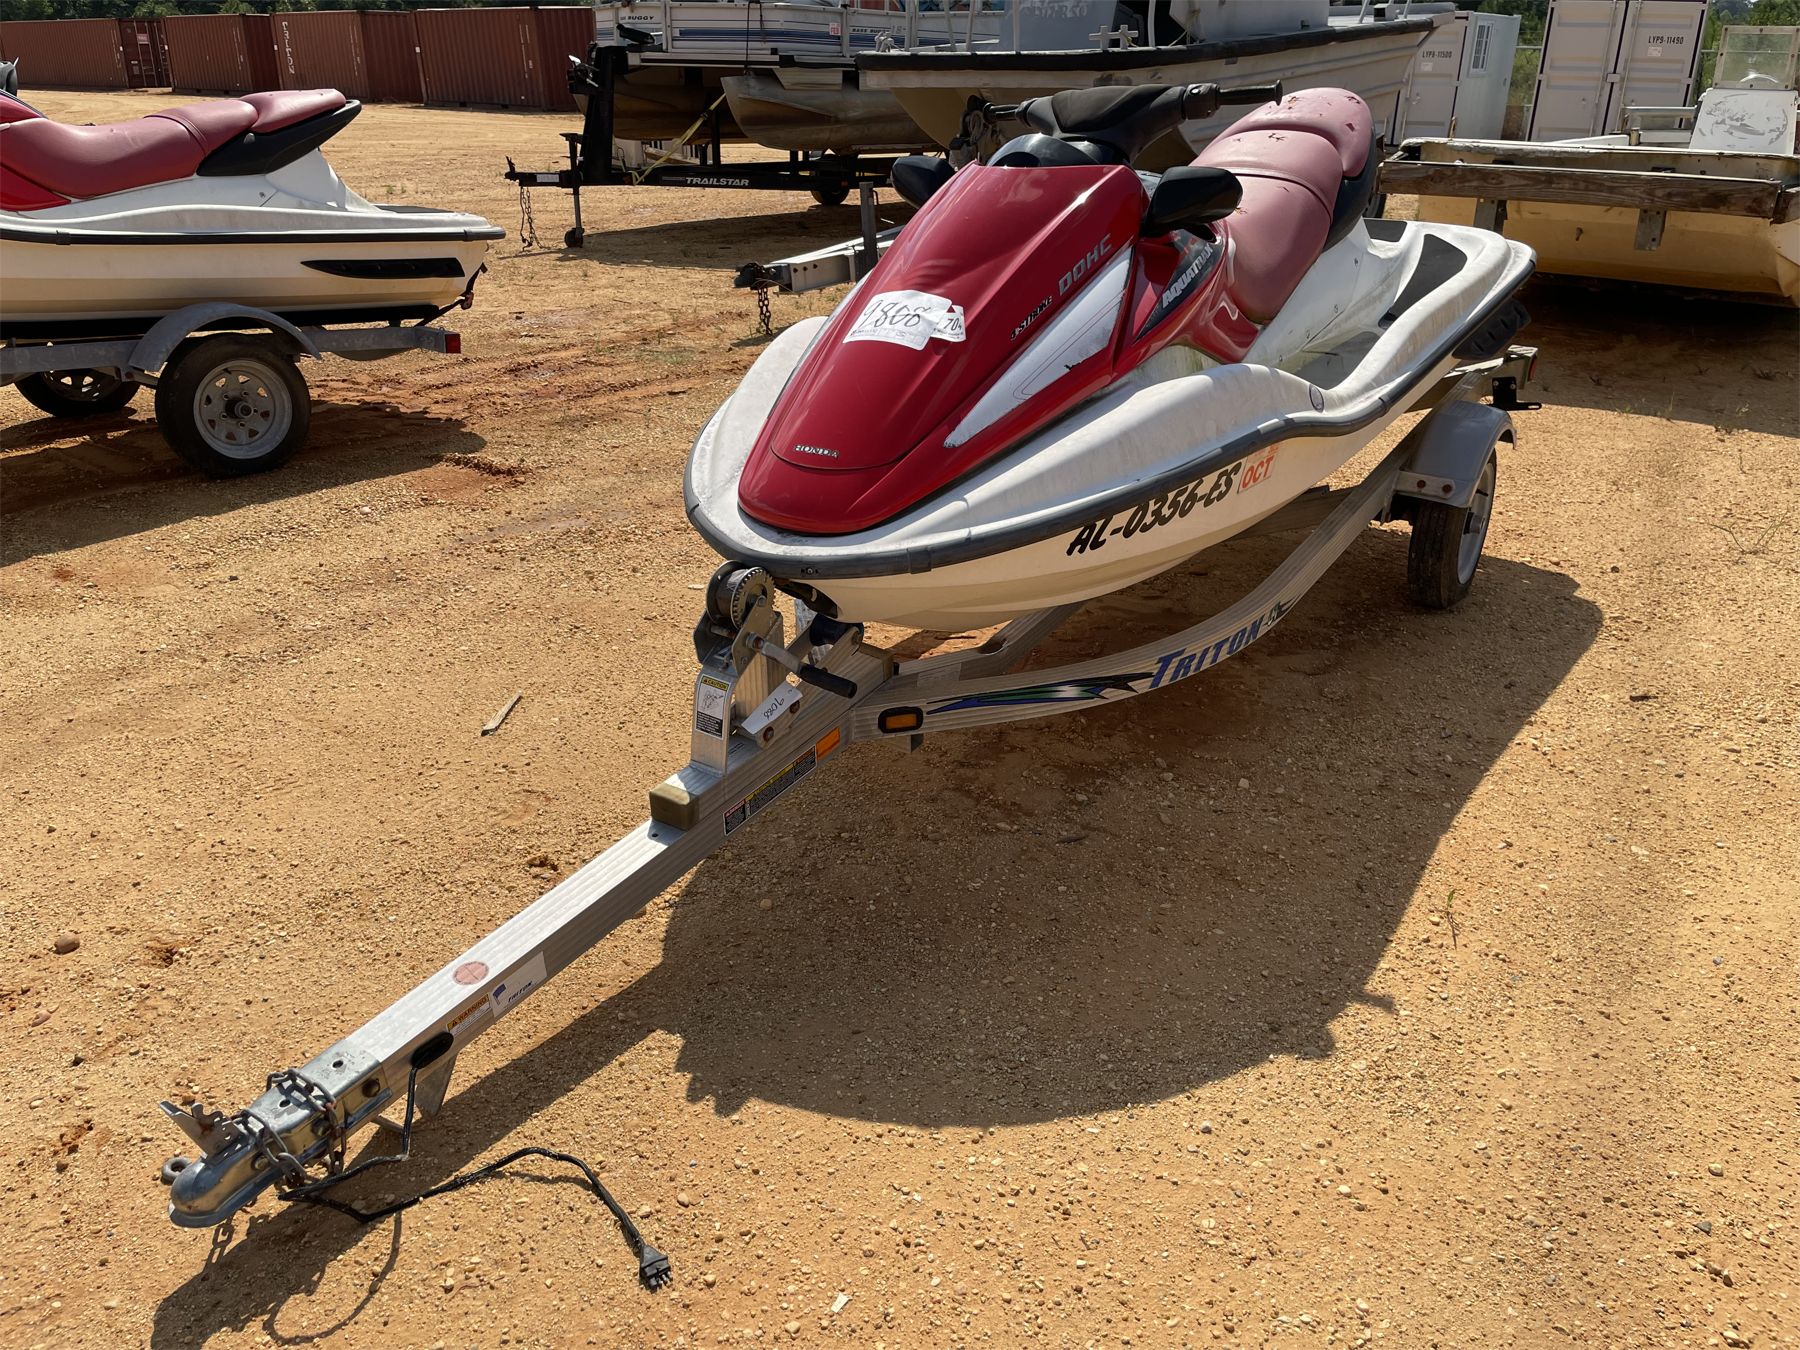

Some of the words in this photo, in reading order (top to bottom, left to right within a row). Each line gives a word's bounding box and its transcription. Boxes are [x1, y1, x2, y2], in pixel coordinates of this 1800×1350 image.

[685, 177, 750, 186] TRAILSTAR
[1058, 232, 1112, 296] DOHC
[795, 444, 839, 458] HONDA
[1242, 454, 1274, 489] OCT
[1066, 461, 1242, 557] AL-0356-ES
[1149, 613, 1266, 690] TRITON
[458, 995, 487, 1023] WARNING
